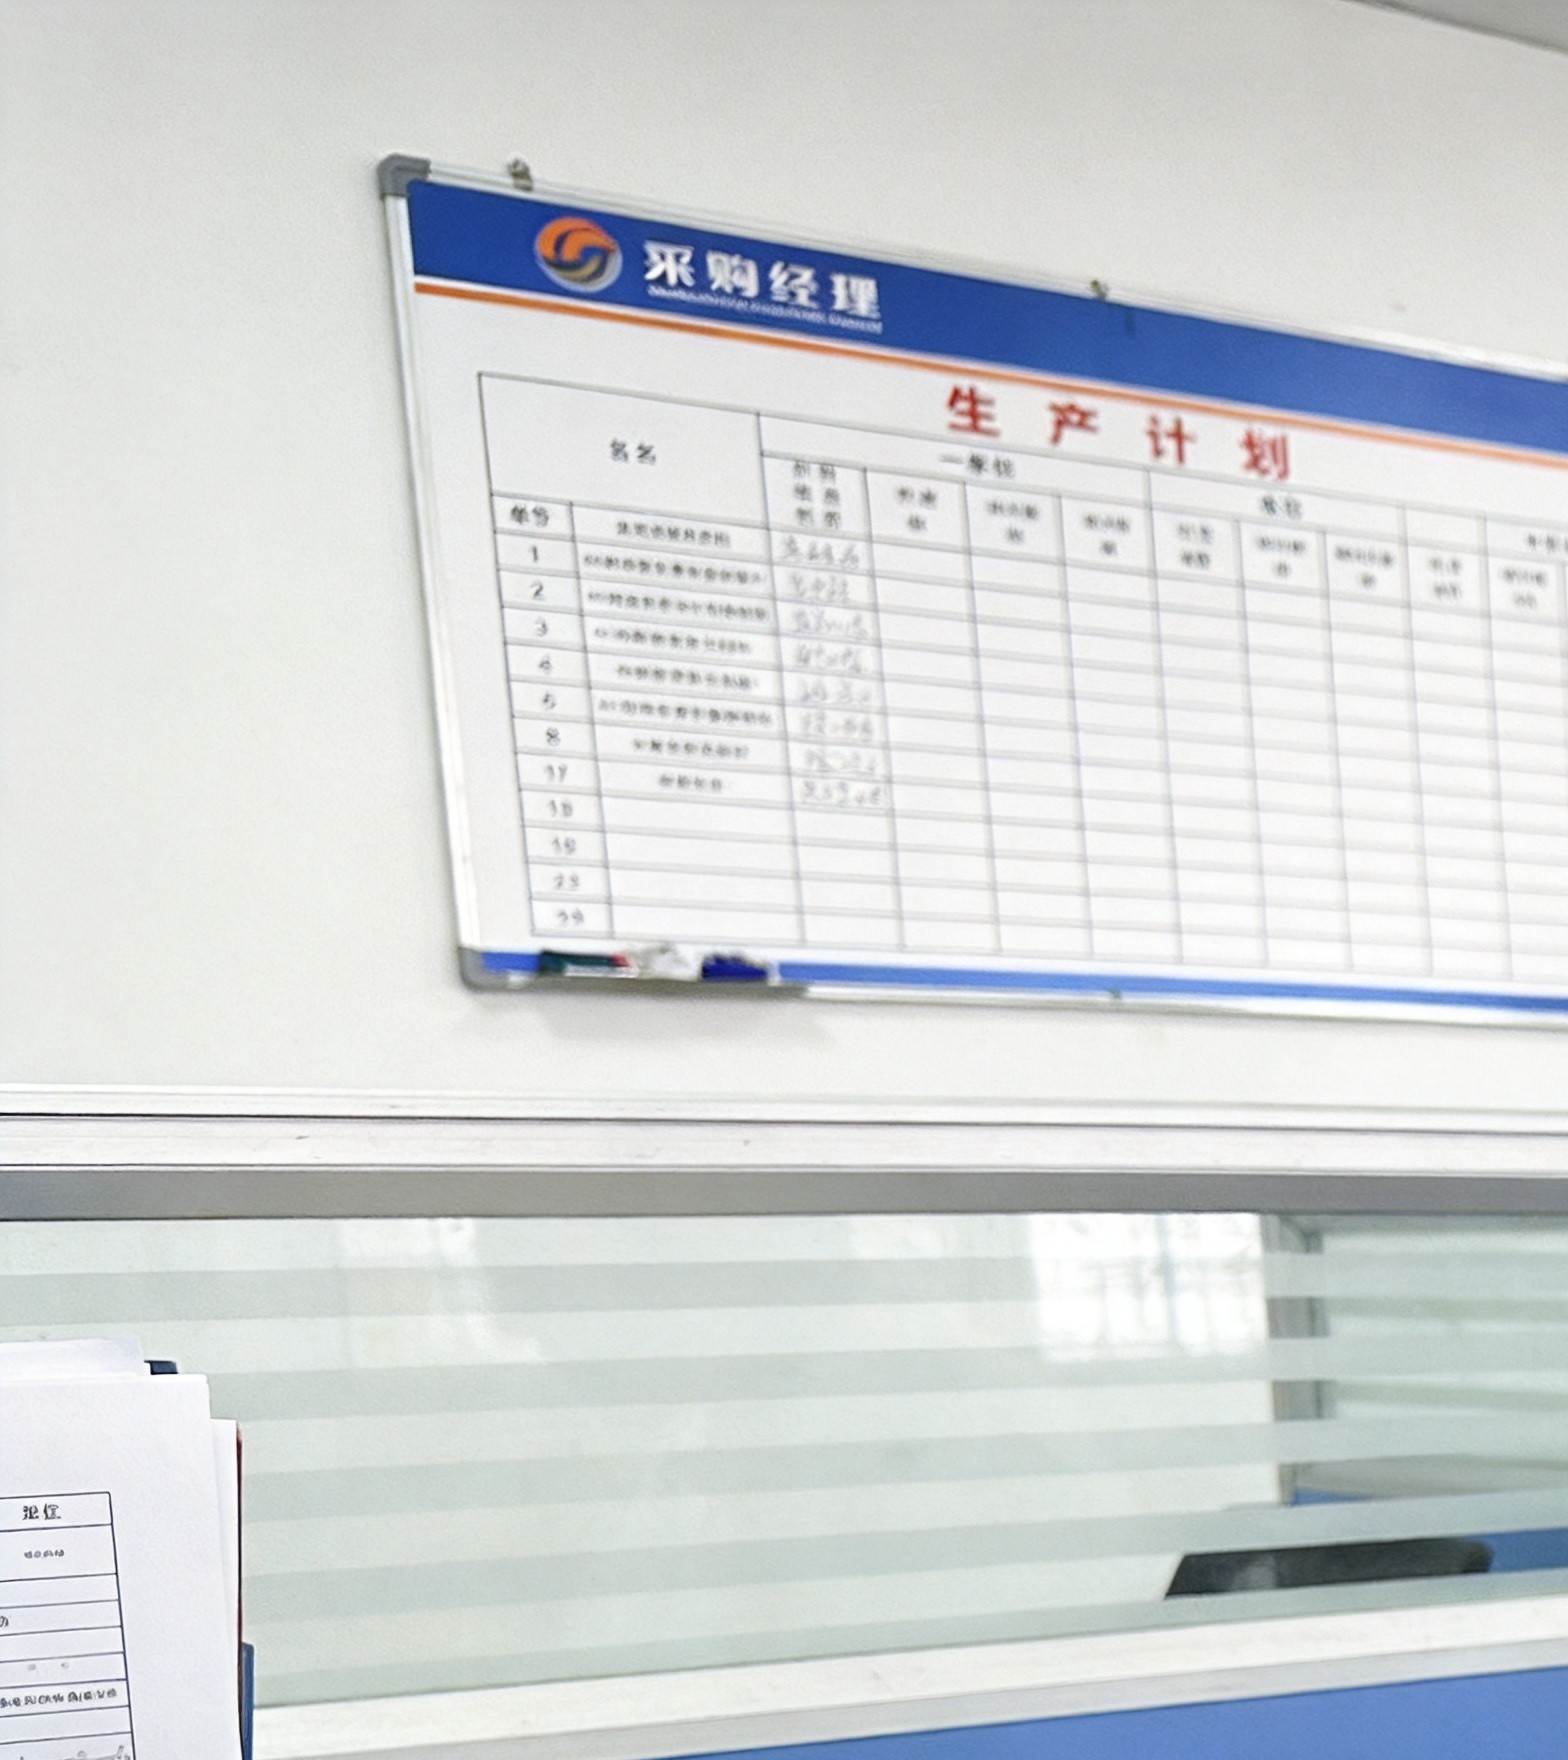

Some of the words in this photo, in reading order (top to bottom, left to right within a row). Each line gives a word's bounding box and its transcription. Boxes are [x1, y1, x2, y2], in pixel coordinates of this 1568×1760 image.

[644, 240, 881, 319] 采购经理
[947, 384, 1287, 480] 生产计划
[530, 580, 544, 601] 2
